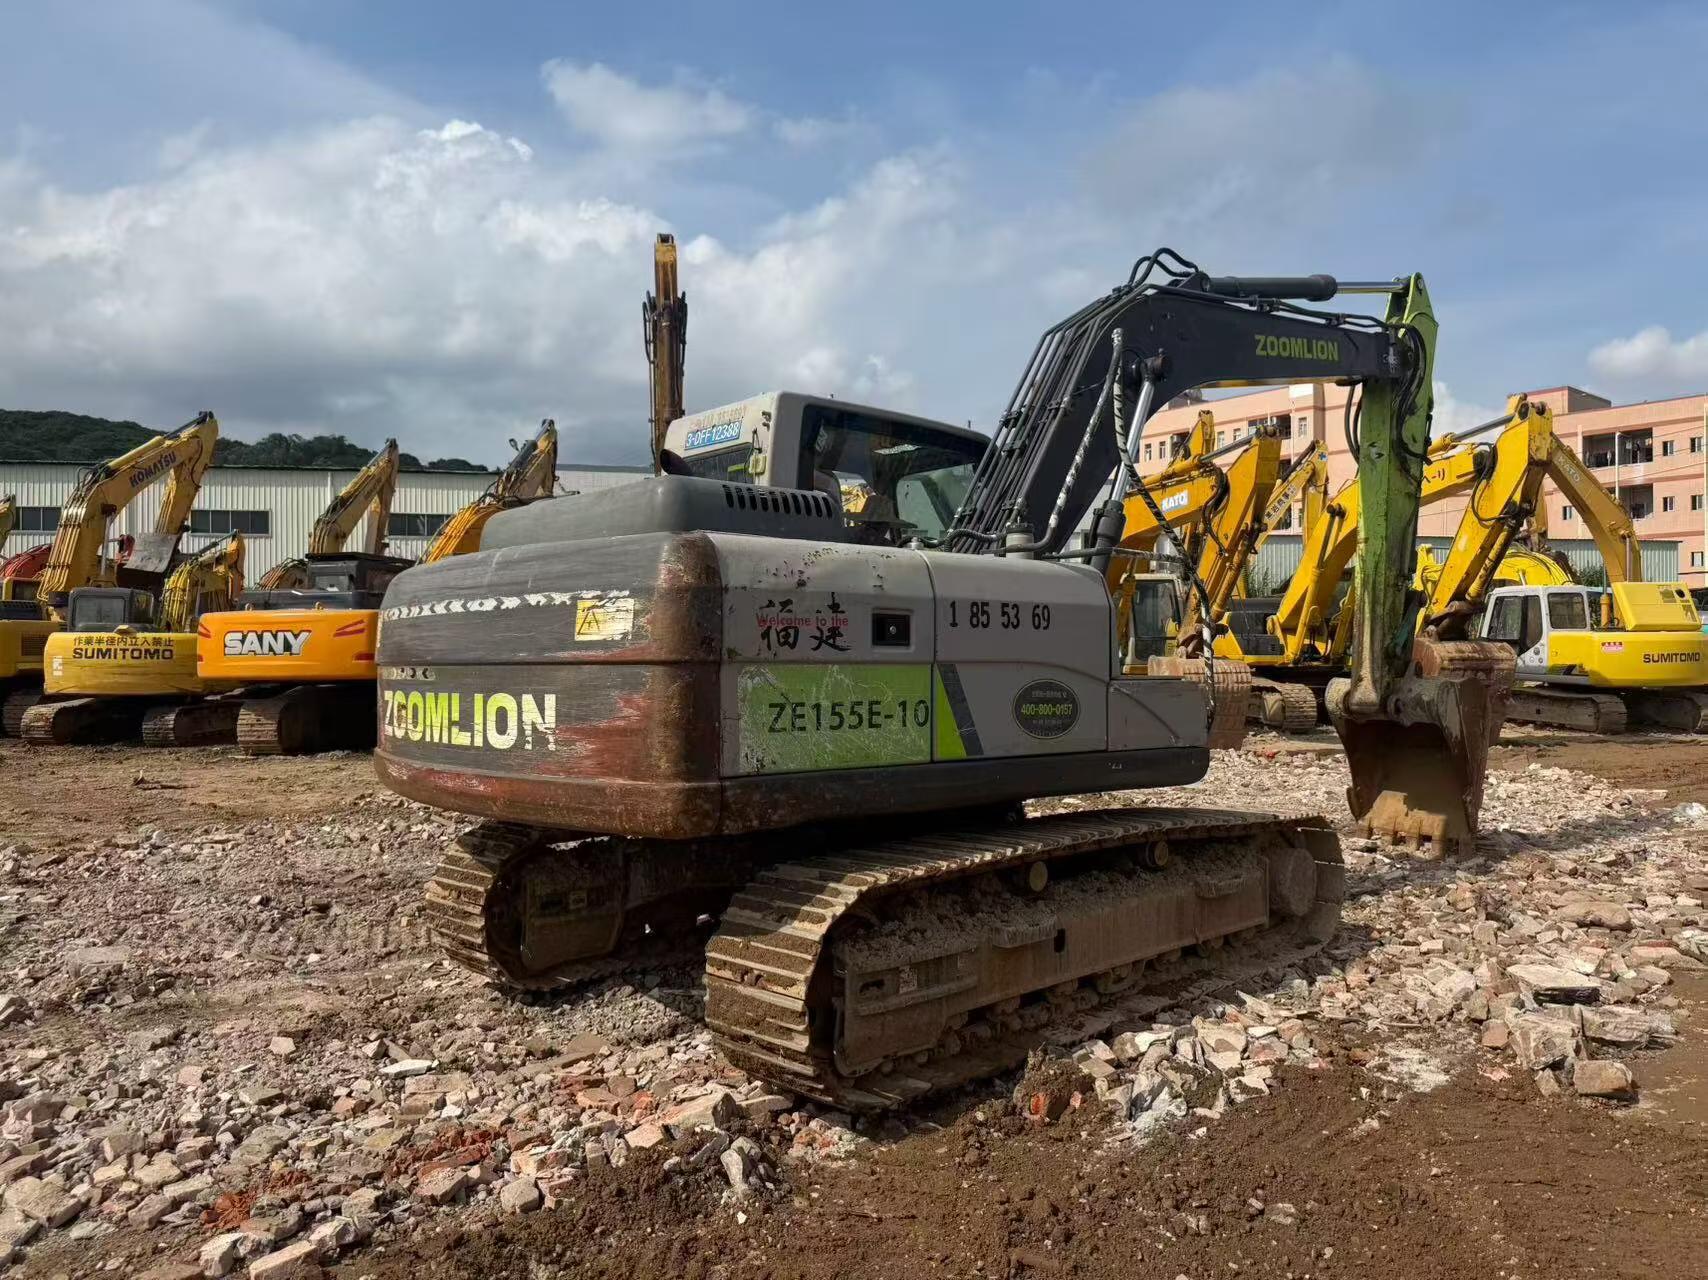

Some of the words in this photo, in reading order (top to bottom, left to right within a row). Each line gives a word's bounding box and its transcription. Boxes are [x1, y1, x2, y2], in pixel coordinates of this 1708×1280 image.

[1254, 334, 1339, 360] ZOOMLION
[129, 451, 176, 487] KOMATSU
[1161, 489, 1188, 511] KATO
[756, 612, 811, 628] Welcome
[815, 615, 827, 627] to
[832, 614, 849, 626] the
[949, 600, 958, 627] 1
[969, 601, 990, 628] 85
[1001, 602, 1020, 629] 53
[1032, 604, 1051, 630] 69
[73, 636, 174, 647] 作業半径内立入禁止
[73, 647, 174, 660] SUMITOMO
[224, 630, 311, 656] SANY
[1643, 652, 1700, 663] SUMITOMO
[384, 690, 557, 751] ZOOMLION
[768, 700, 930, 733] ZE155E-10
[1021, 703, 1072, 715] 400-800-0157
